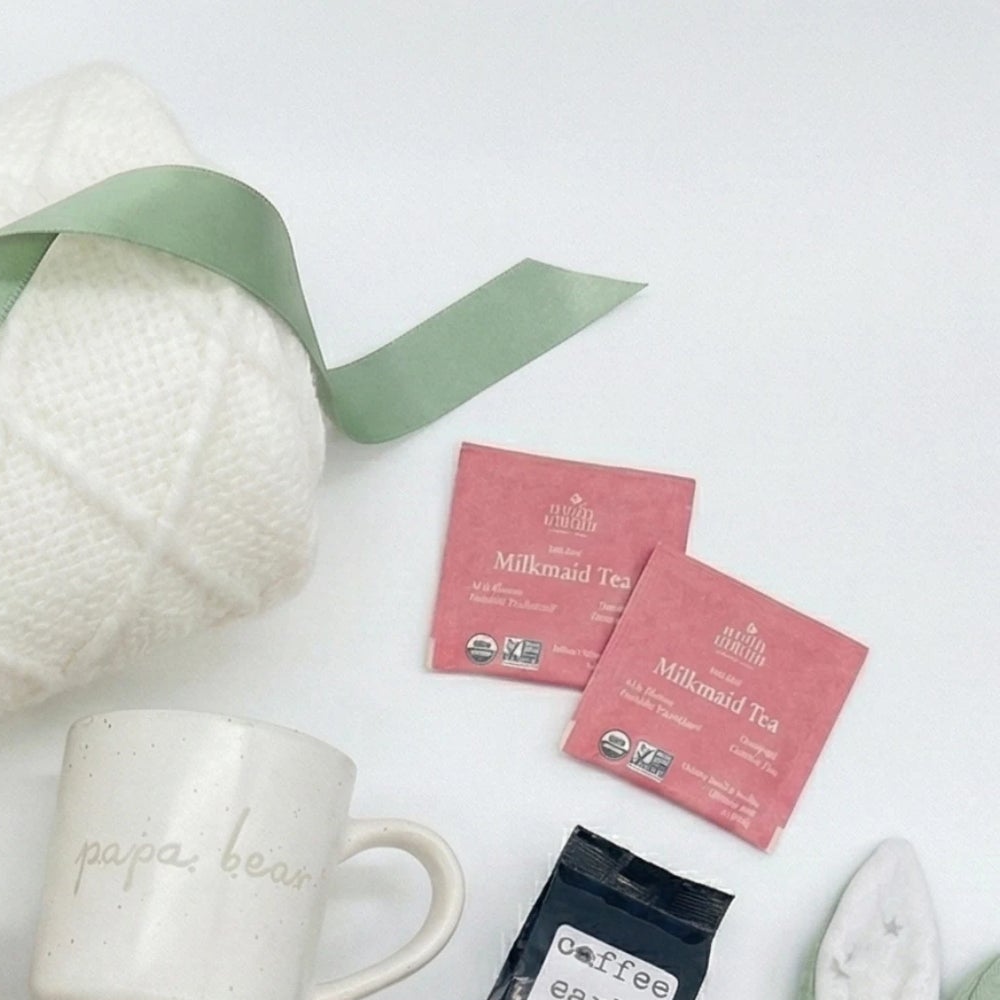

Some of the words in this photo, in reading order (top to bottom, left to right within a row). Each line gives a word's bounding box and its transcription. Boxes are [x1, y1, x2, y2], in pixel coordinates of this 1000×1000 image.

[493, 551, 591, 584] Milkmaid
[597, 567, 631, 589] Tea
[653, 657, 747, 715] Milkmaid
[749, 702, 780, 734] Tea
[74, 841, 199, 897] papa
[221, 806, 312, 890] bear
